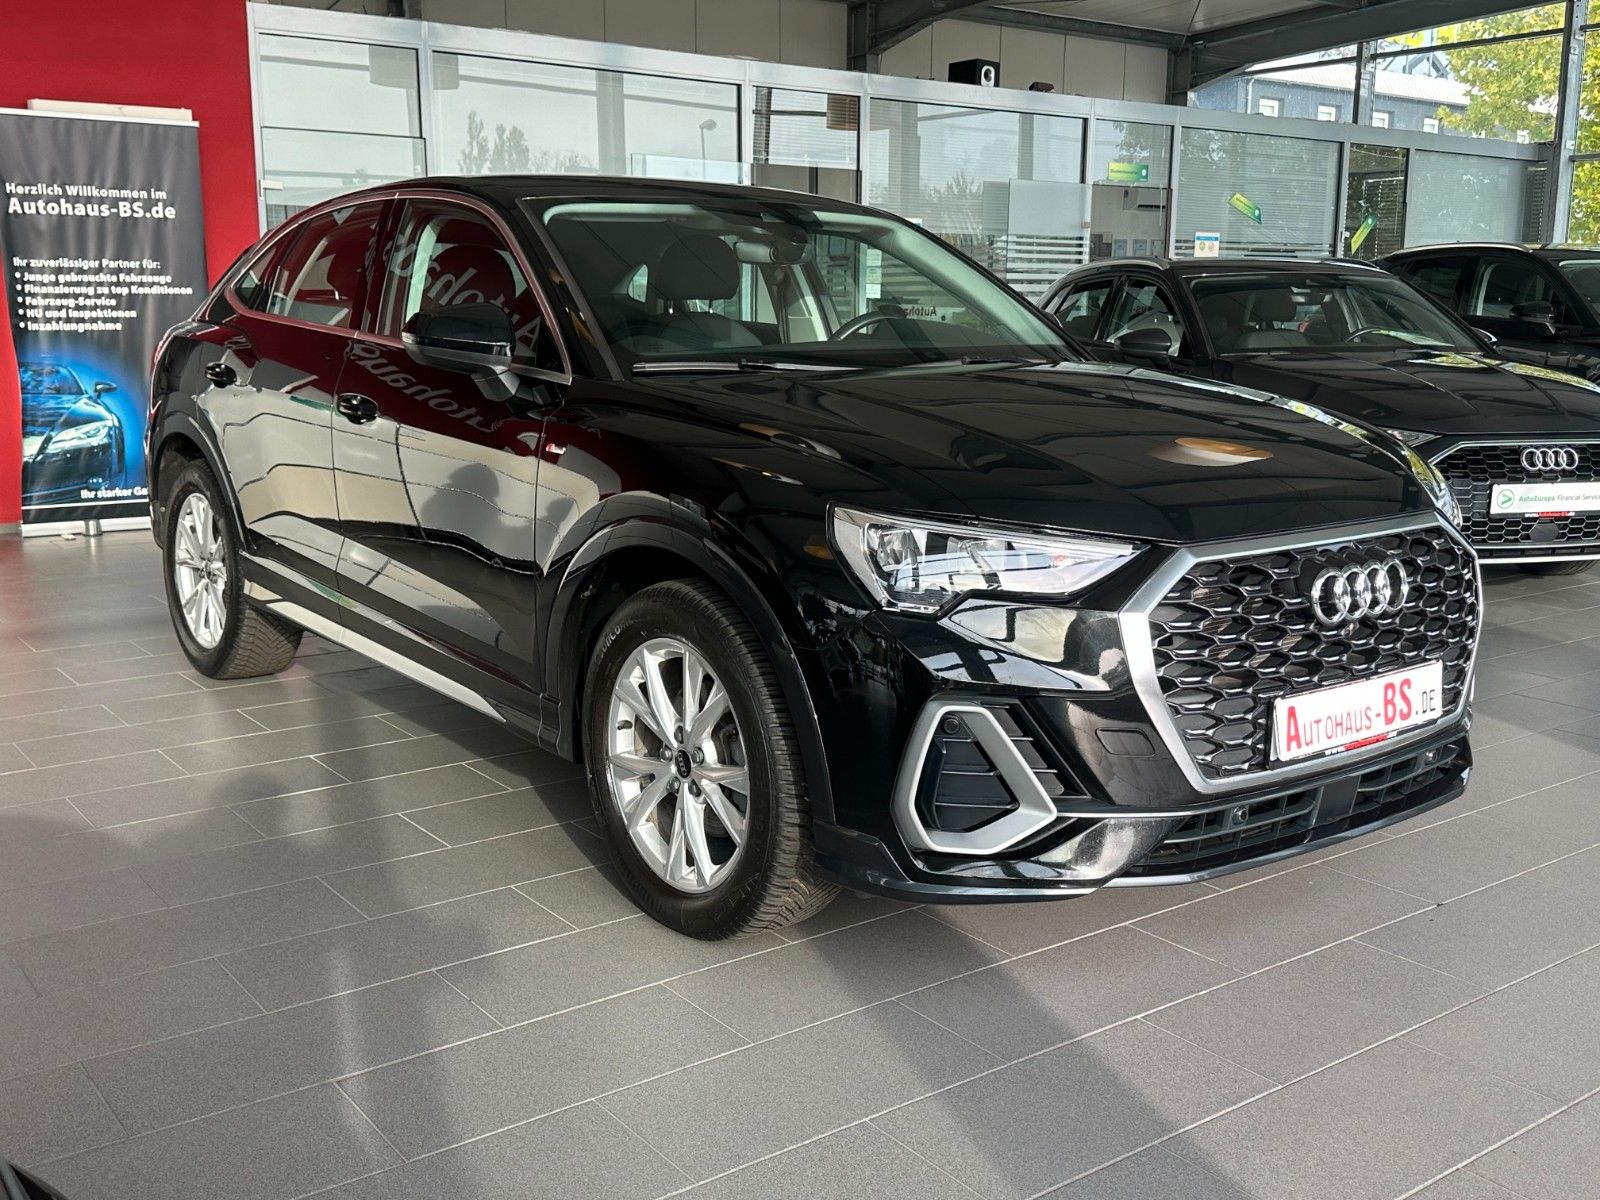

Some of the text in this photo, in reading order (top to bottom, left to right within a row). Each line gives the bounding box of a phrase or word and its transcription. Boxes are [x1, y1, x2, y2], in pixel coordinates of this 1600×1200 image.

[5, 182, 167, 199] Herzlich Willkommen im
[8, 197, 176, 218] Autohaus-BS.de
[13, 256, 161, 270] Ihr zuverlässiger Partner für:
[23, 271, 172, 284] Junge gebrauchte Fahrzeuge
[24, 284, 193, 296] Finanzierung zu top Konditionen
[25, 296, 117, 308] Fahrzeug-Service
[26, 308, 137, 319] HU und Inspektionen
[81, 486, 149, 499] Ihr starker Ga
